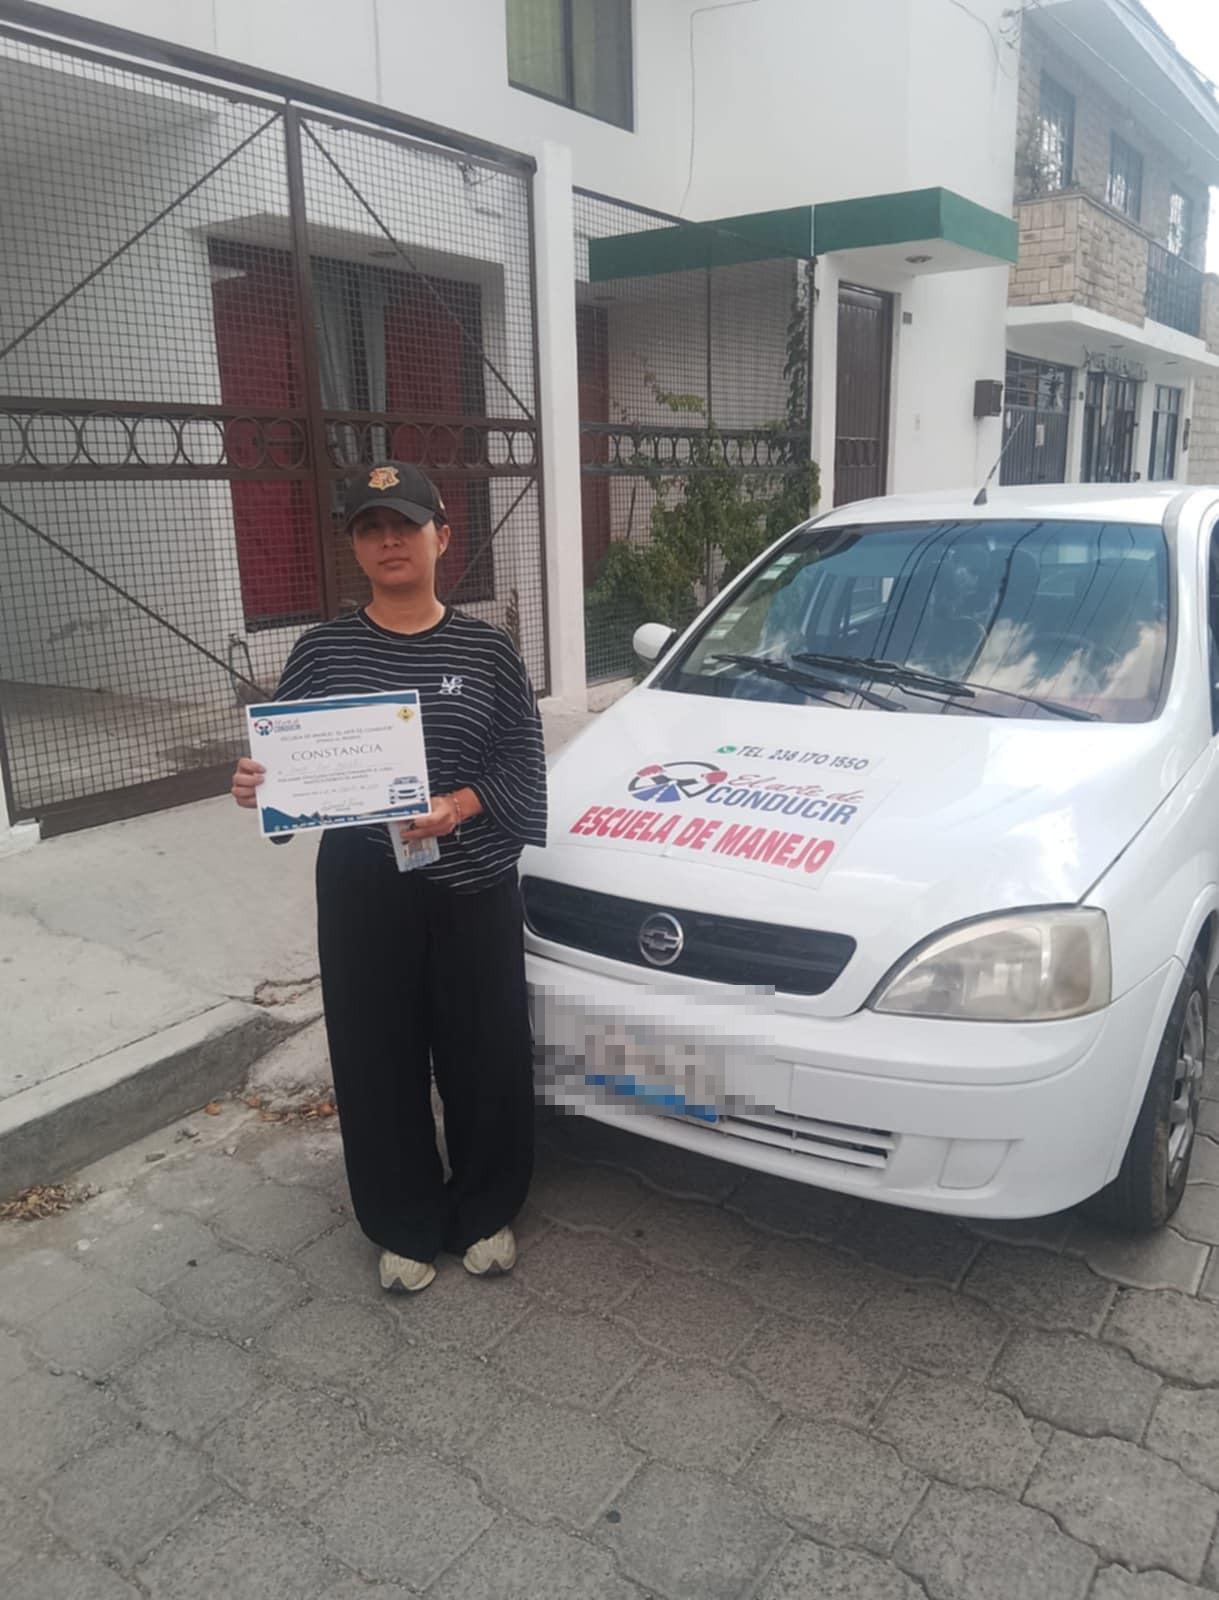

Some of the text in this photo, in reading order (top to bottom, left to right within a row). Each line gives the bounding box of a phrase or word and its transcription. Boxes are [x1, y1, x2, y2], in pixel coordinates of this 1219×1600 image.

[291, 743, 384, 761] CONSTANCIA
[768, 749, 800, 761] 238
[798, 752, 830, 765] 170
[828, 756, 869, 770] 1550
[728, 774, 865, 803] El arte de
[705, 786, 858, 825] CONDUCIR
[569, 805, 836, 874] ESCUELA DE MANEJO
